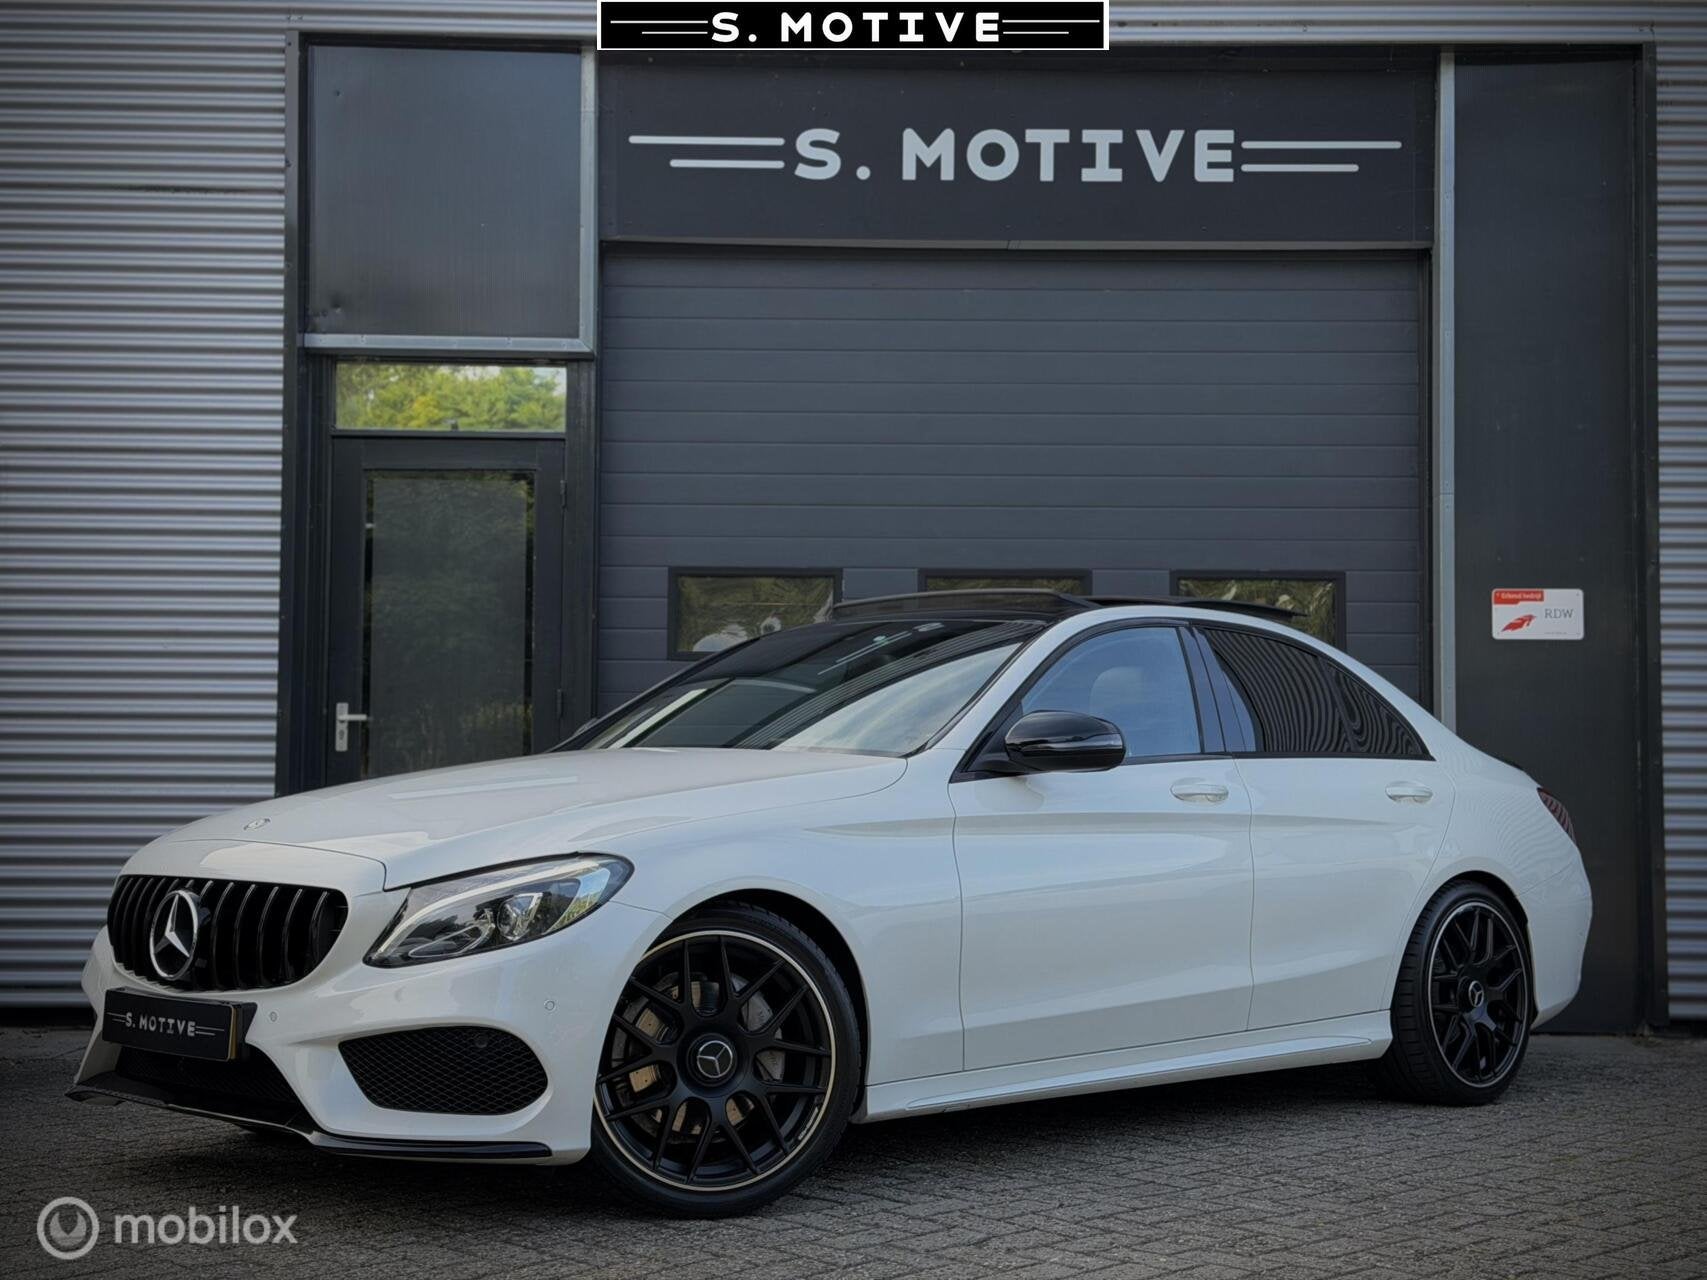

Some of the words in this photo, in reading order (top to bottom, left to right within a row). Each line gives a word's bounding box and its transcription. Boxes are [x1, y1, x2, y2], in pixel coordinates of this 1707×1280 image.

[794, 128, 871, 181] S.
[902, 127, 1235, 183] MOTIVE
[1544, 608, 1573, 619] RDW
[125, 1011, 136, 1029] S.
[139, 1013, 197, 1038] MOTIVE
